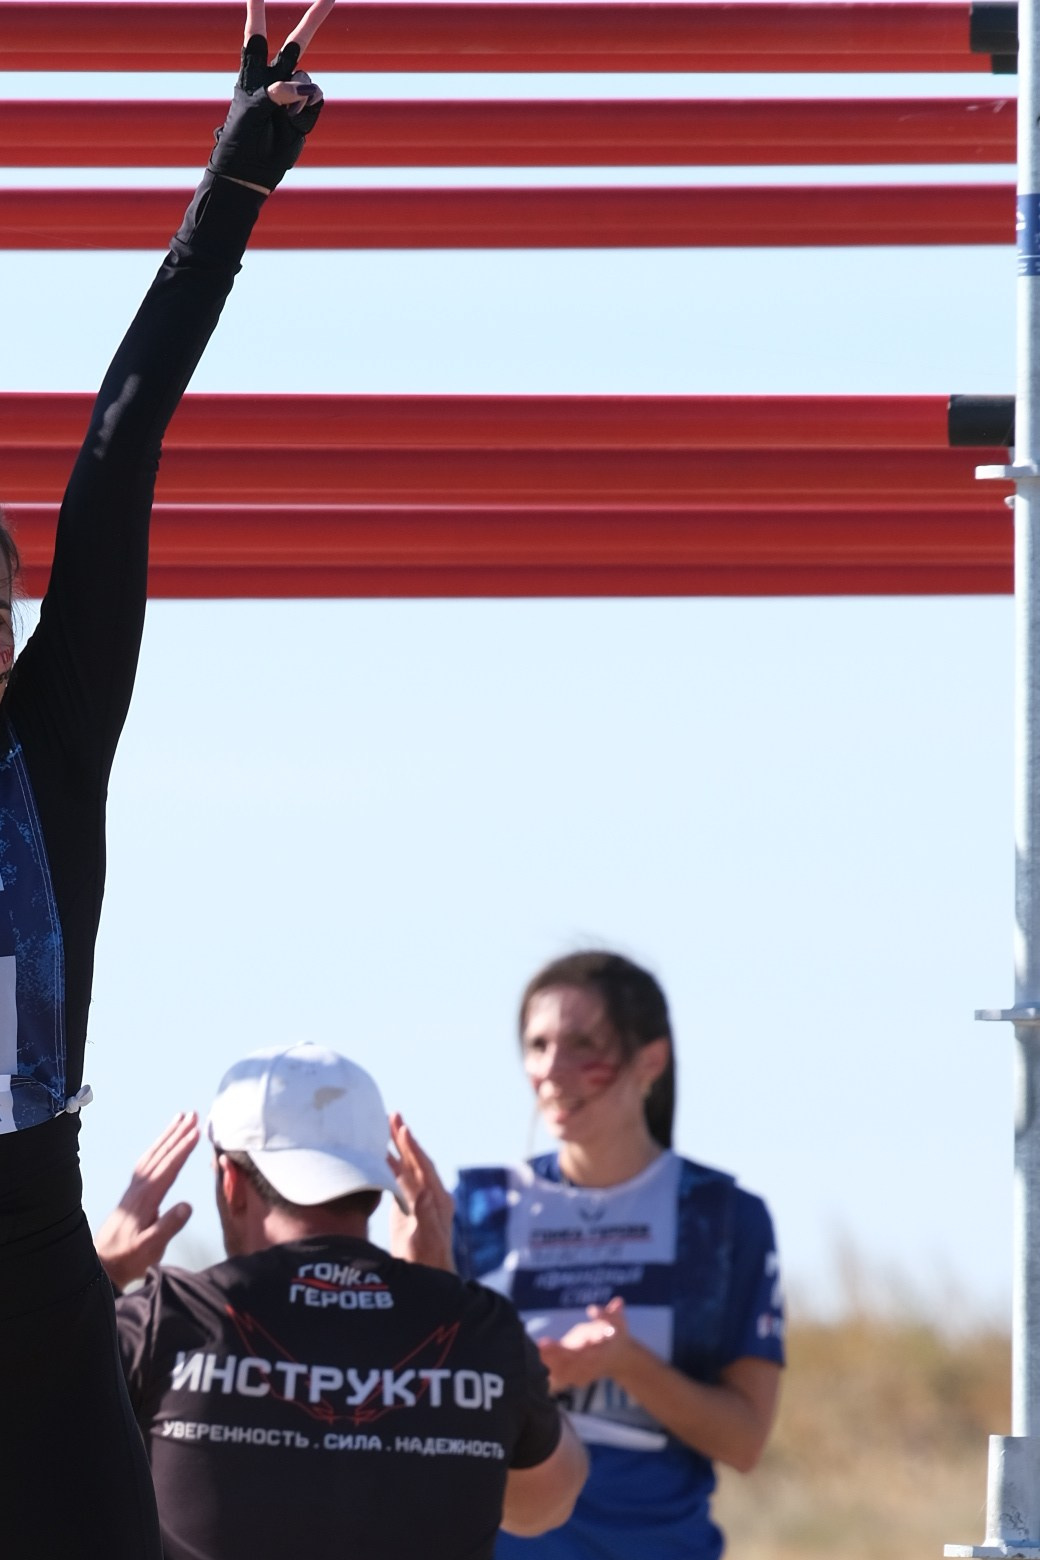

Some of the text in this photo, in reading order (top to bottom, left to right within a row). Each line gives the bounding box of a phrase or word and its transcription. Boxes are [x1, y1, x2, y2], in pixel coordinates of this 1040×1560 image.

[298, 1262, 383, 1286] ГОНКА
[289, 1283, 394, 1310] ГЕРОЕВ
[171, 1351, 505, 1411] ИНСТРУКТОР
[395, 1436, 505, 1460] НАДЕЖНОСТЬ
